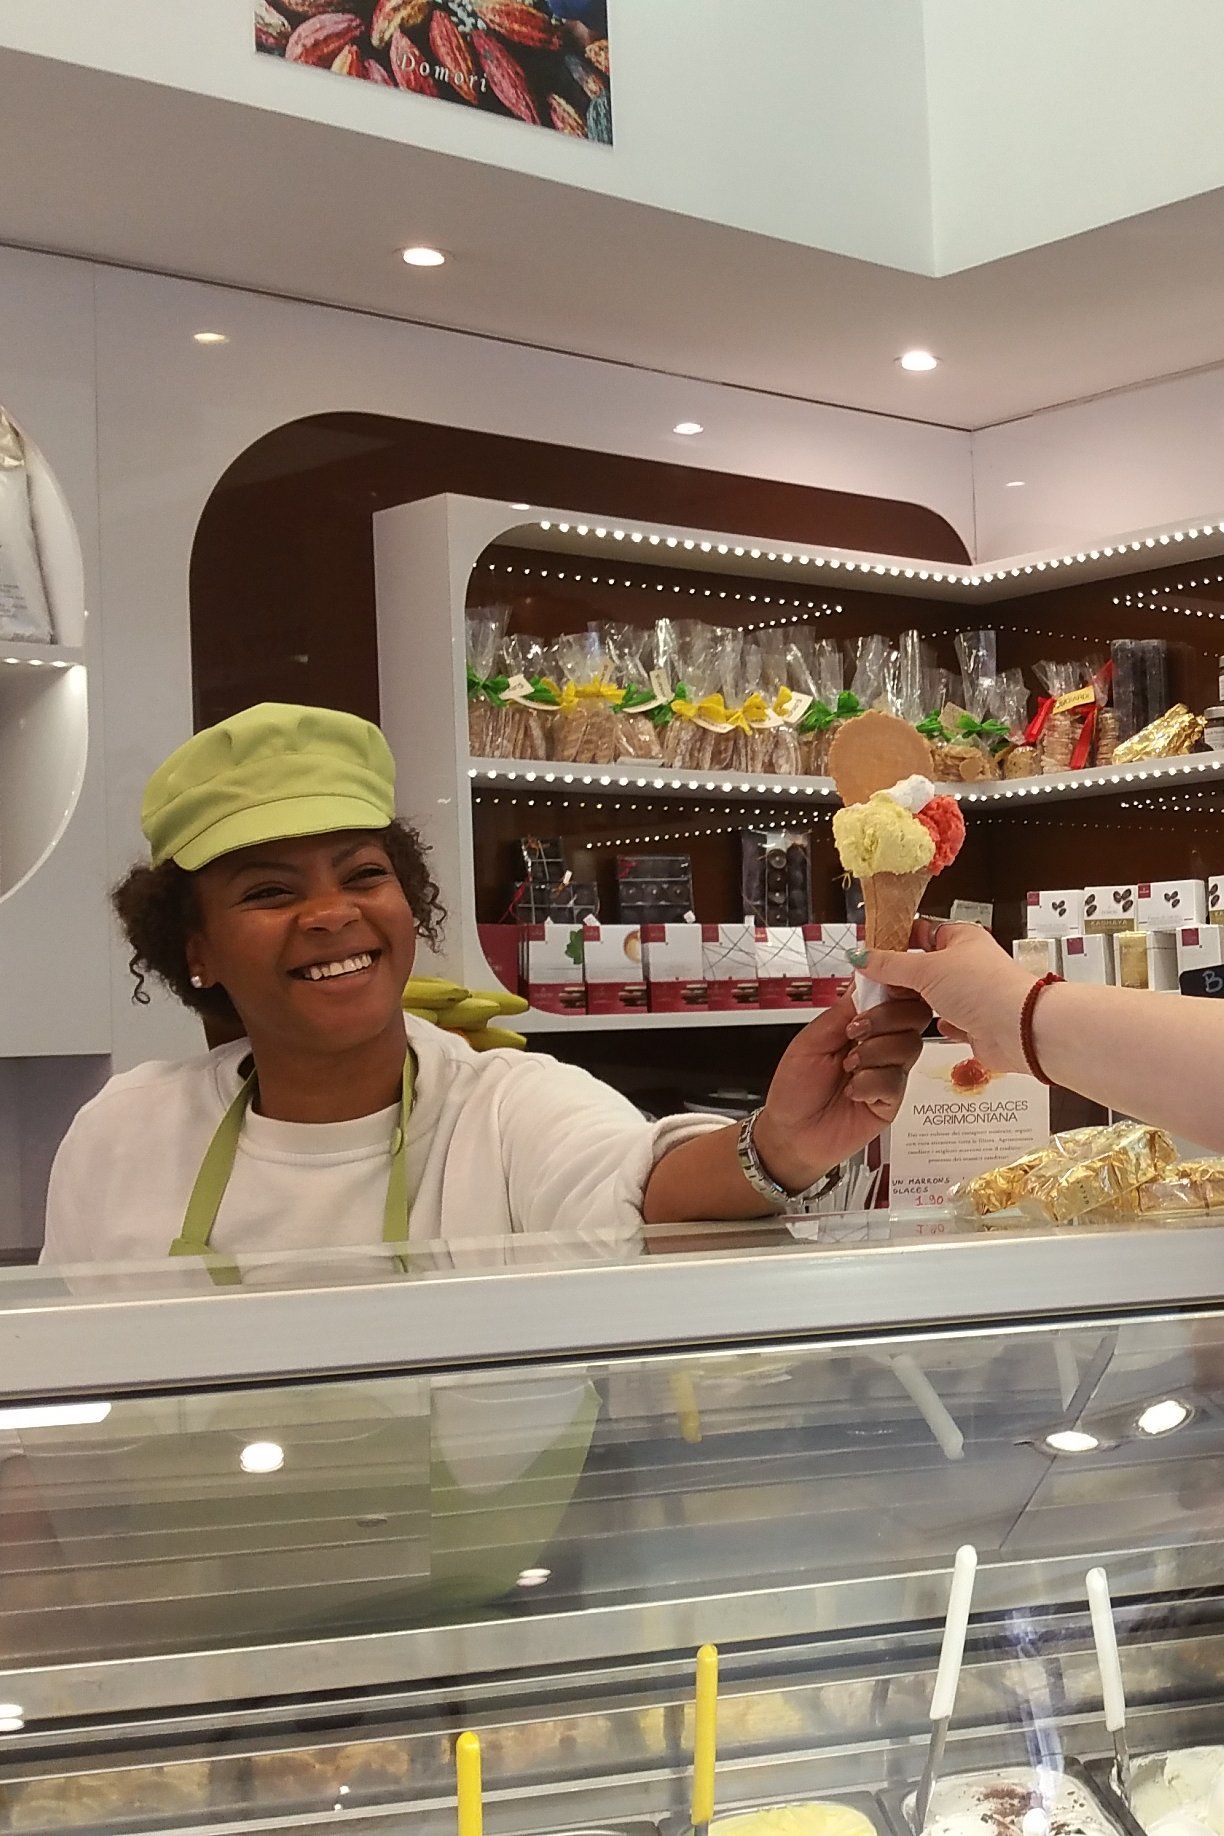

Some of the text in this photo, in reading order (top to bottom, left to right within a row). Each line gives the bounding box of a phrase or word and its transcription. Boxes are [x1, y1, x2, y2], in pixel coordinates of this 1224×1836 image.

[400, 51, 488, 93] Domori
[913, 1100, 1029, 1115] MARRONS GLACES
[922, 1112, 1018, 1126] AGRIMONTANA
[908, 1177, 950, 1185] MARRONS
